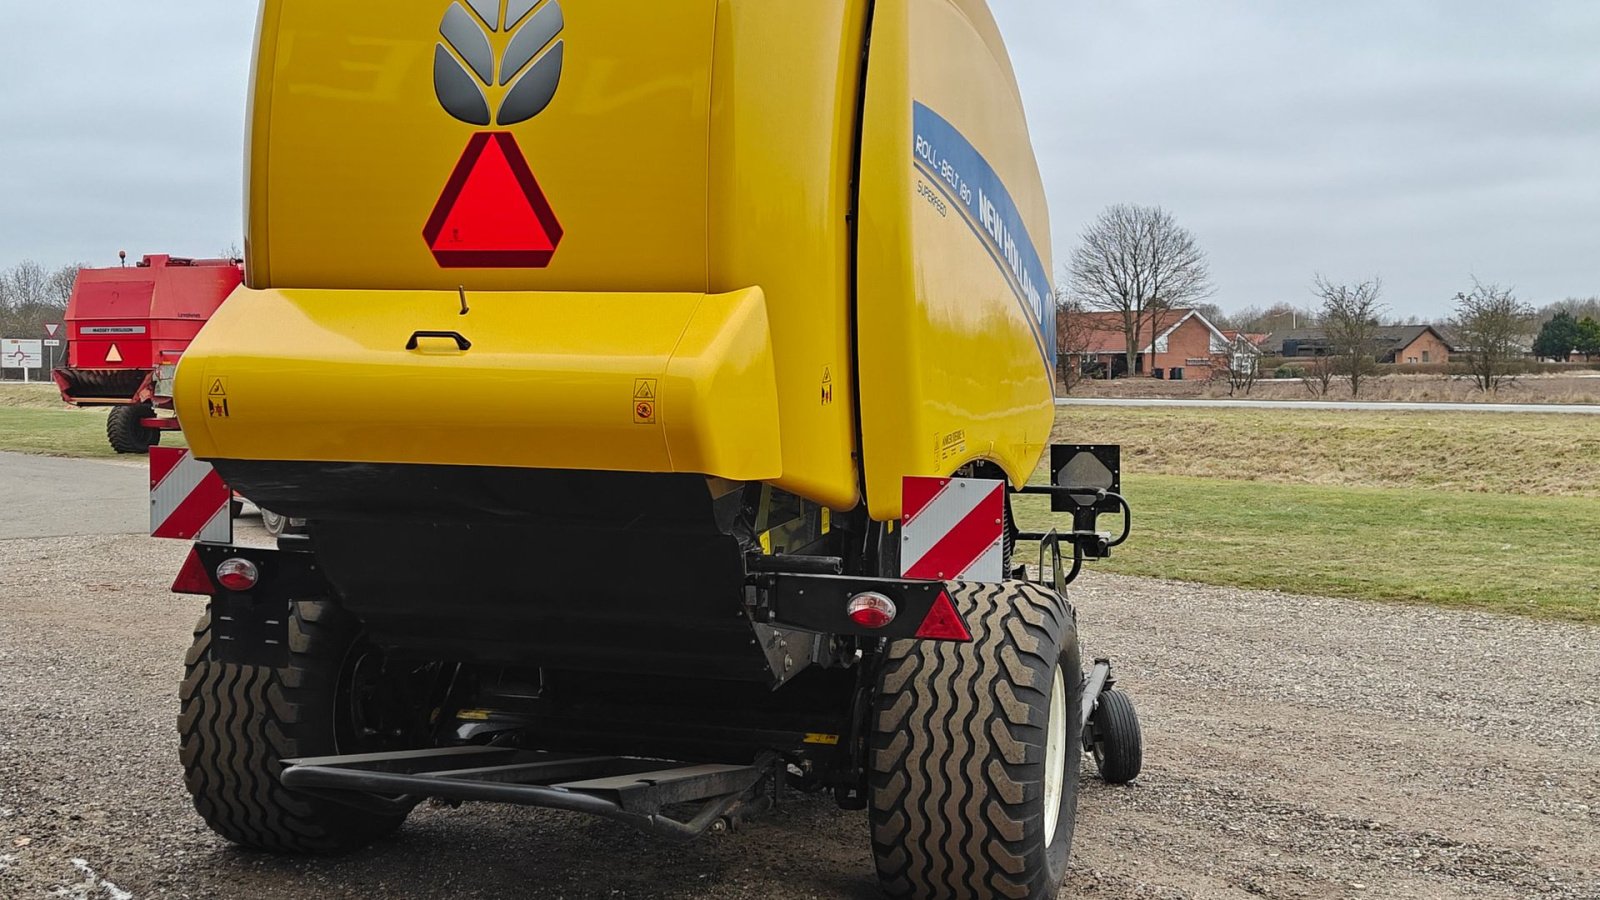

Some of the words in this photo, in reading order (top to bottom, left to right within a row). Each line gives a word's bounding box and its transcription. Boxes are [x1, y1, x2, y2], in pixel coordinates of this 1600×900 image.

[915, 134, 960, 190] ROLL-BELT
[960, 179, 972, 206] 180
[917, 180, 947, 217] SUPERFEED
[978, 187, 1003, 249] NEW
[1003, 225, 1042, 325] HOLLAND
